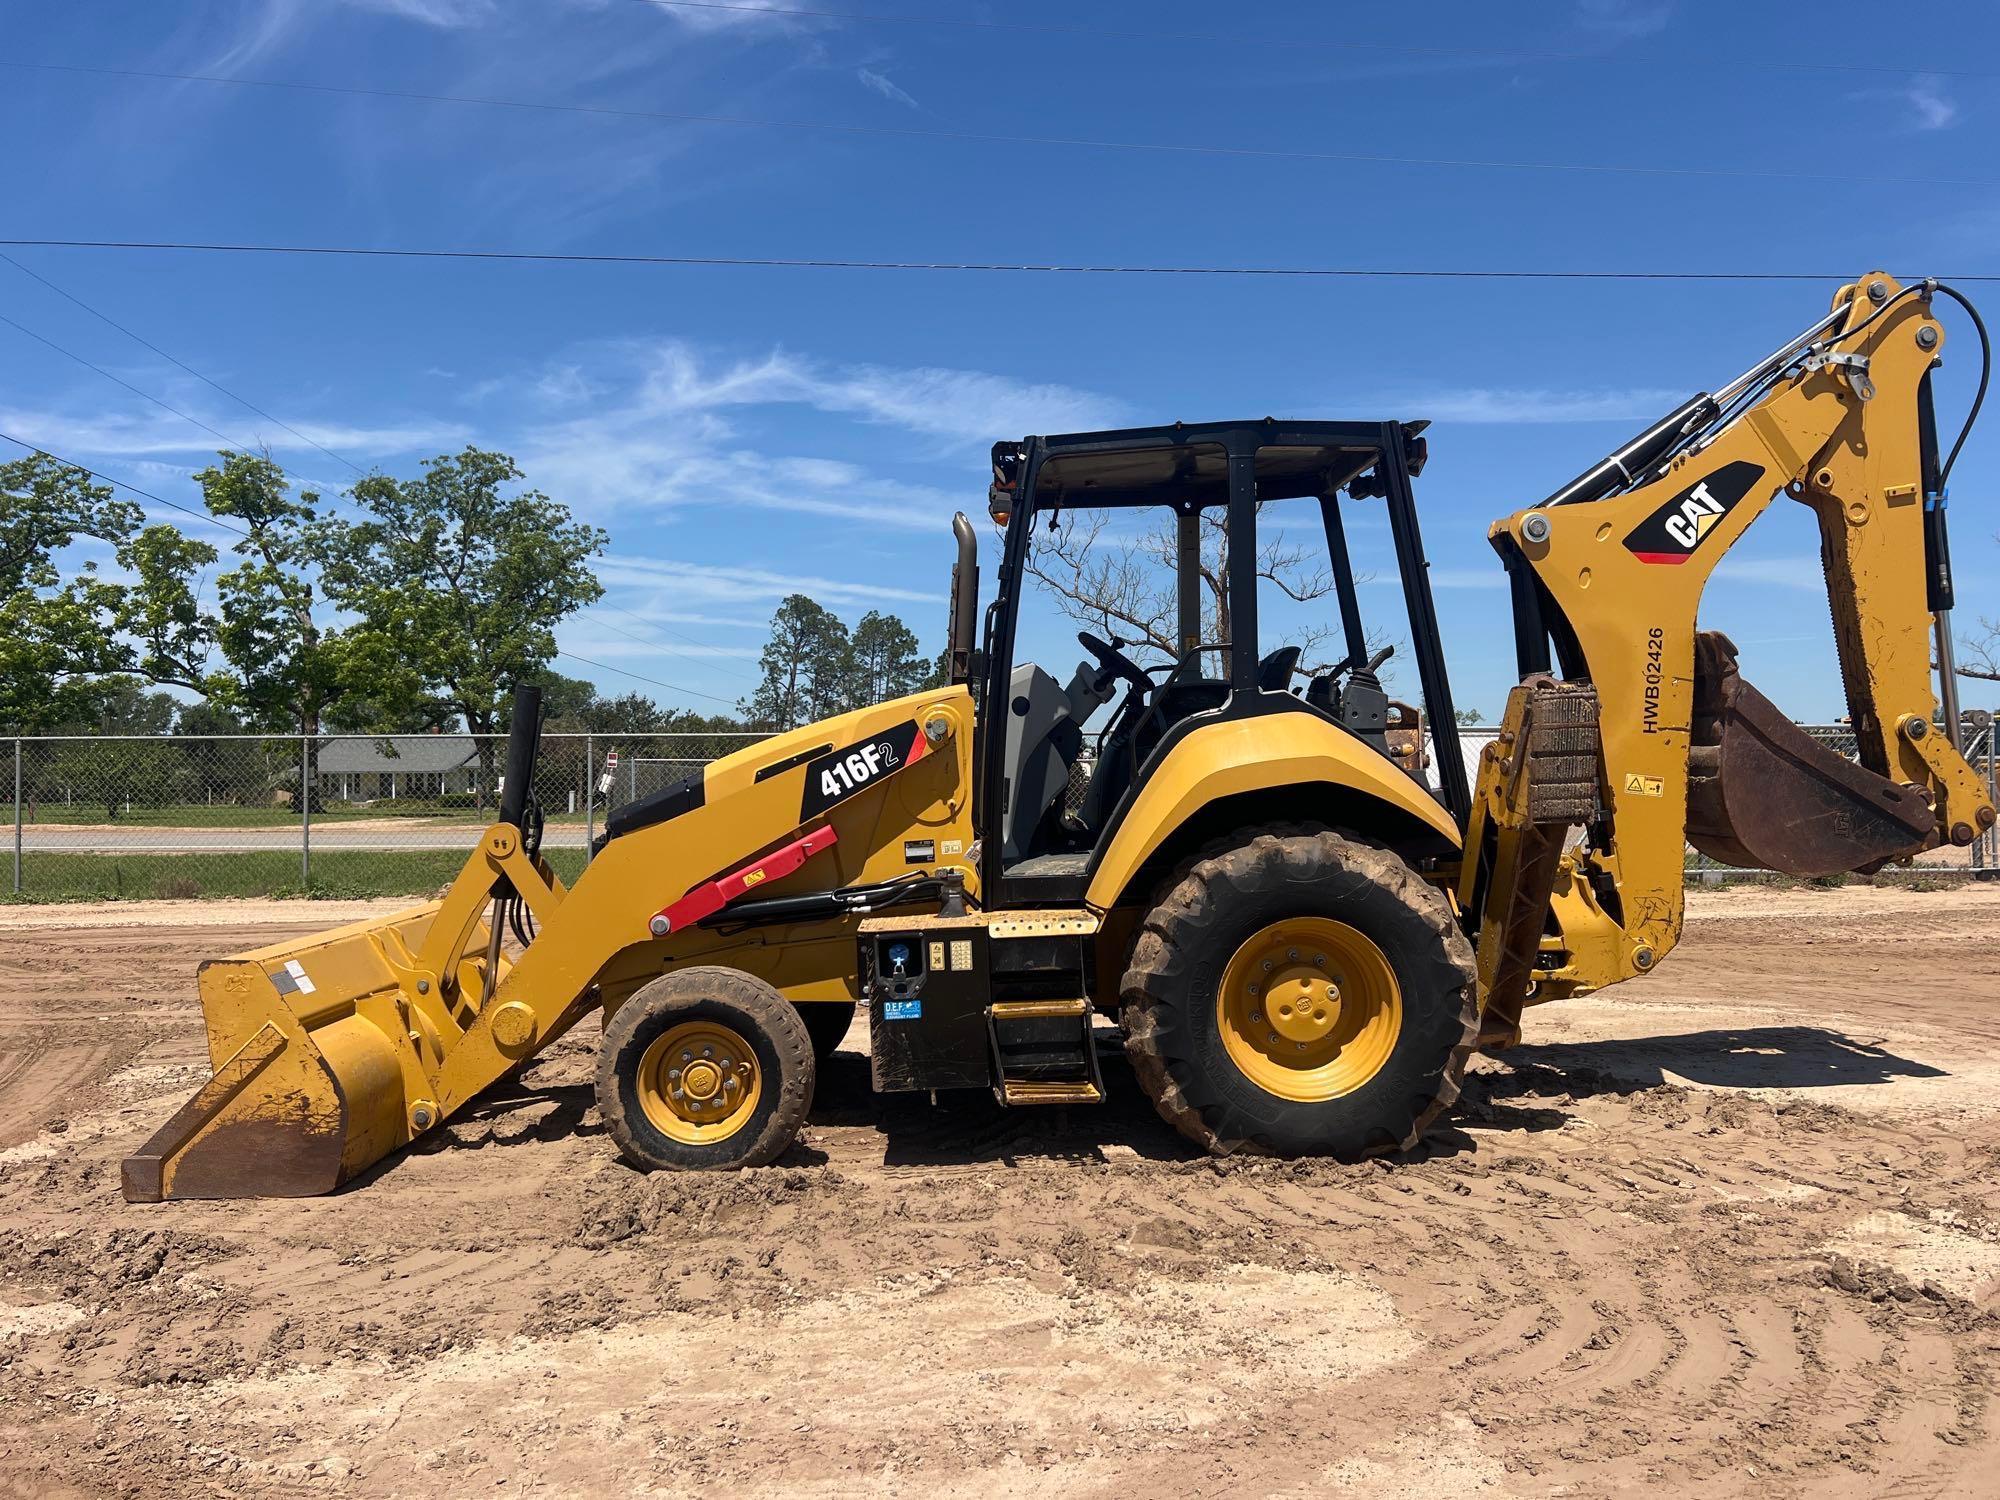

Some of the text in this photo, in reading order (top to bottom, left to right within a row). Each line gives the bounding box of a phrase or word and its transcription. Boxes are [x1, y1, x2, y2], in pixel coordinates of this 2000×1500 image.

[1665, 481, 1726, 548] CAT
[1643, 627, 1664, 734] HWB02426
[821, 742, 899, 796] 416F2
